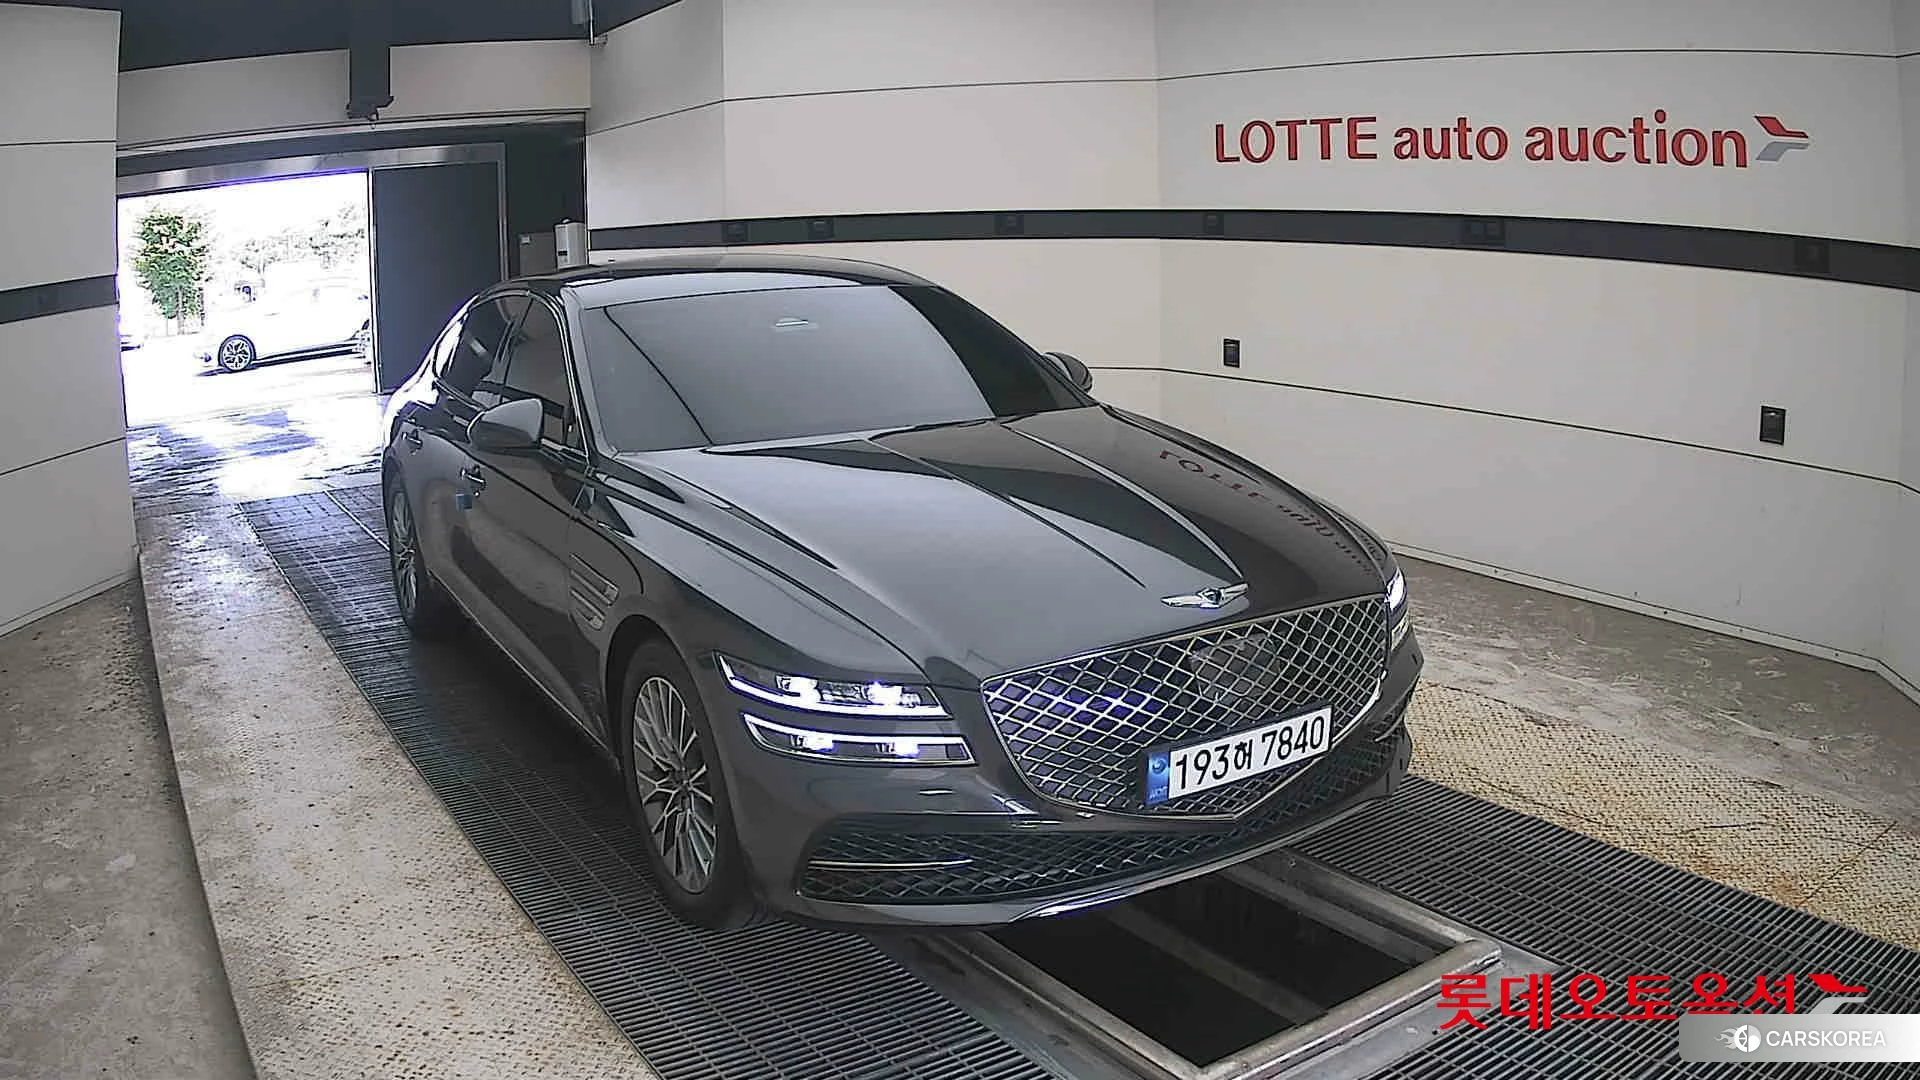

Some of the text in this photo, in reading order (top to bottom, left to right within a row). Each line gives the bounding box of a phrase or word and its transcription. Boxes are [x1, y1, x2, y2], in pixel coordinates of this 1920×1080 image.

[1215, 109, 1749, 168] LOTTE auto auction
[1175, 716, 1325, 789] 193허 7840
